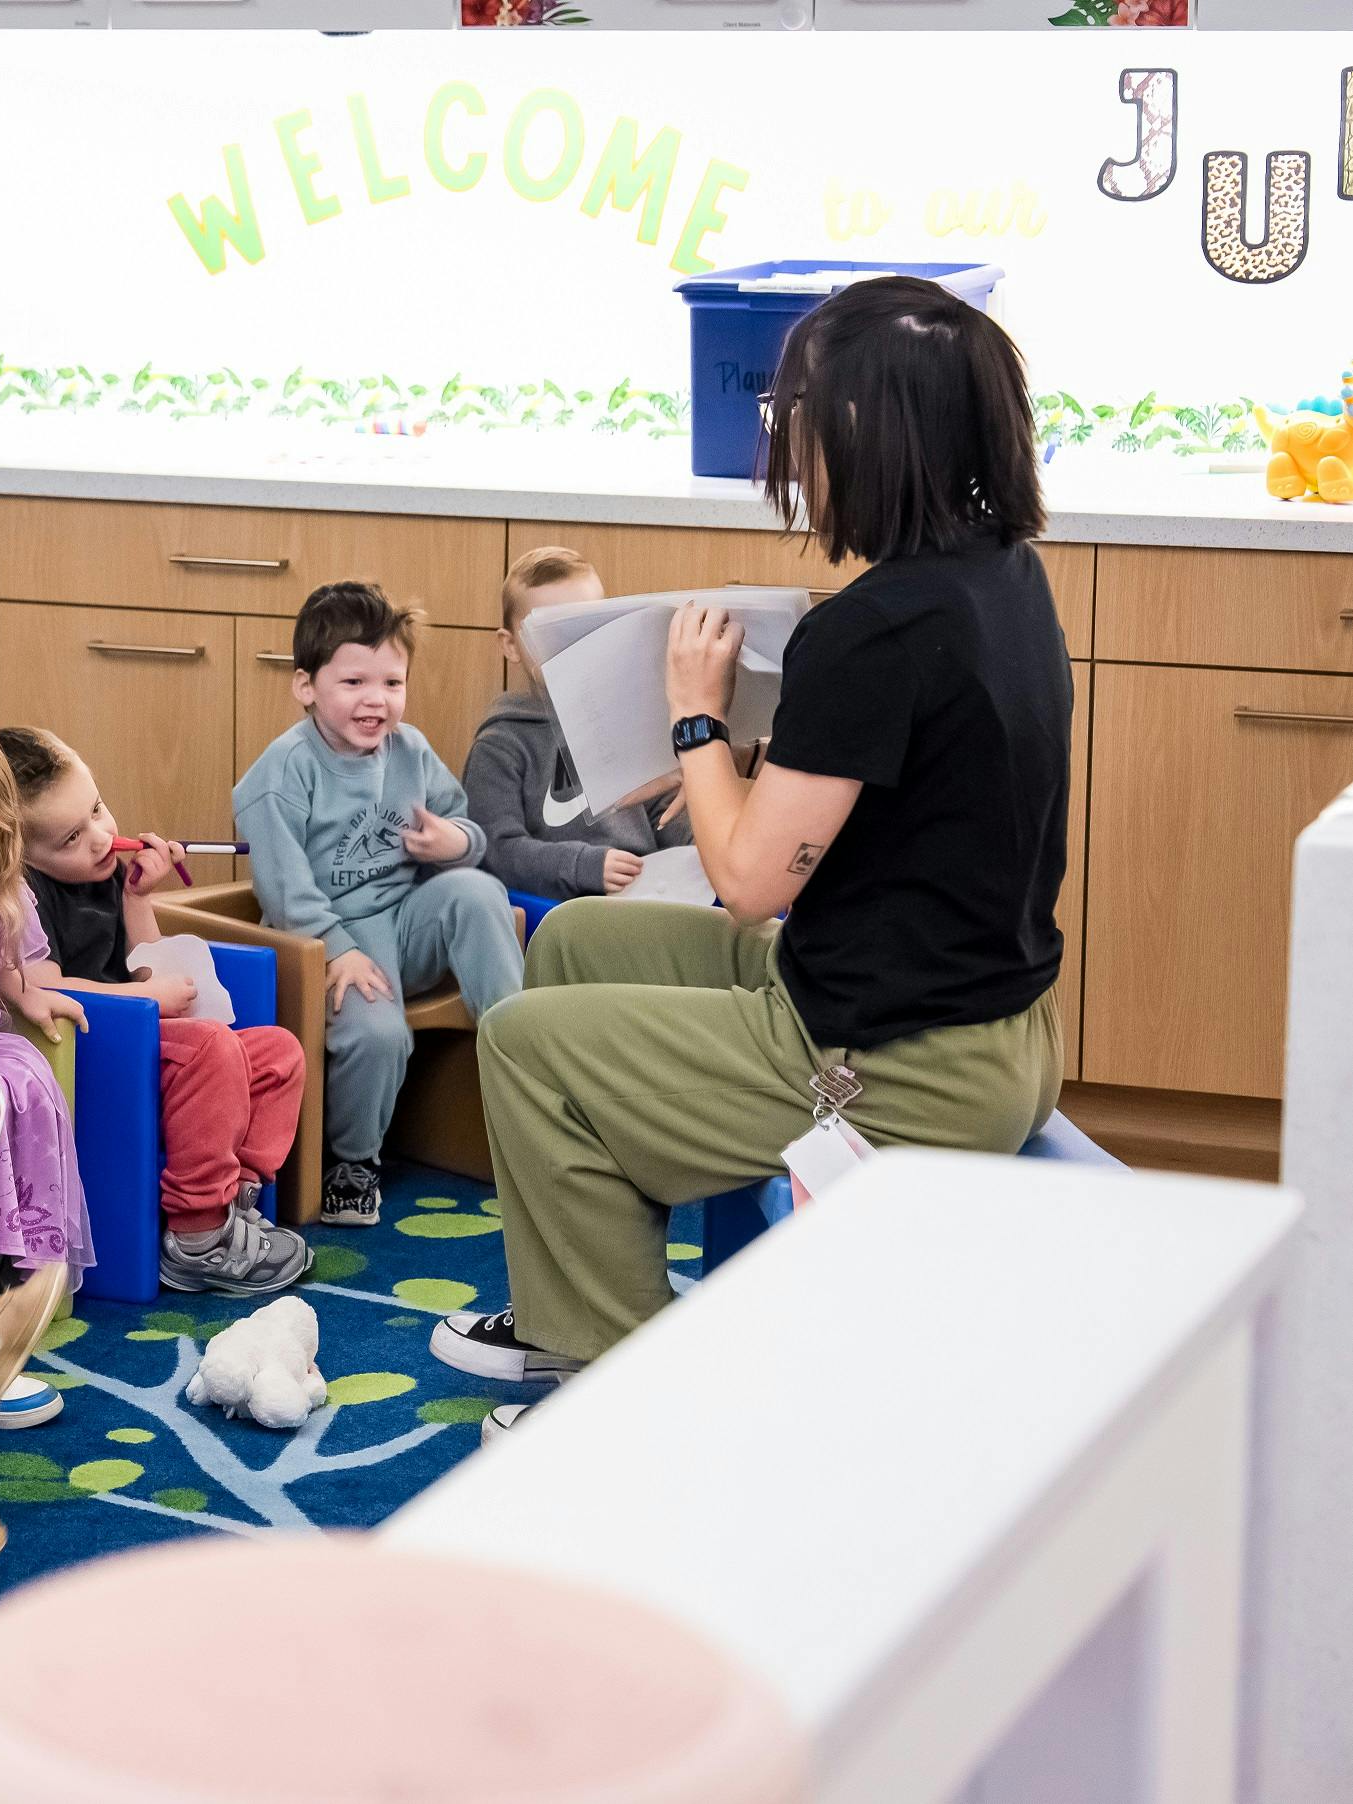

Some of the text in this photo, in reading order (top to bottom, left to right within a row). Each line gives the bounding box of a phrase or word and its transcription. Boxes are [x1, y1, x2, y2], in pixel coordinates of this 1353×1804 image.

[167, 66, 1353, 285] WELCOME to our JU
[350, 807, 368, 830] DAY
